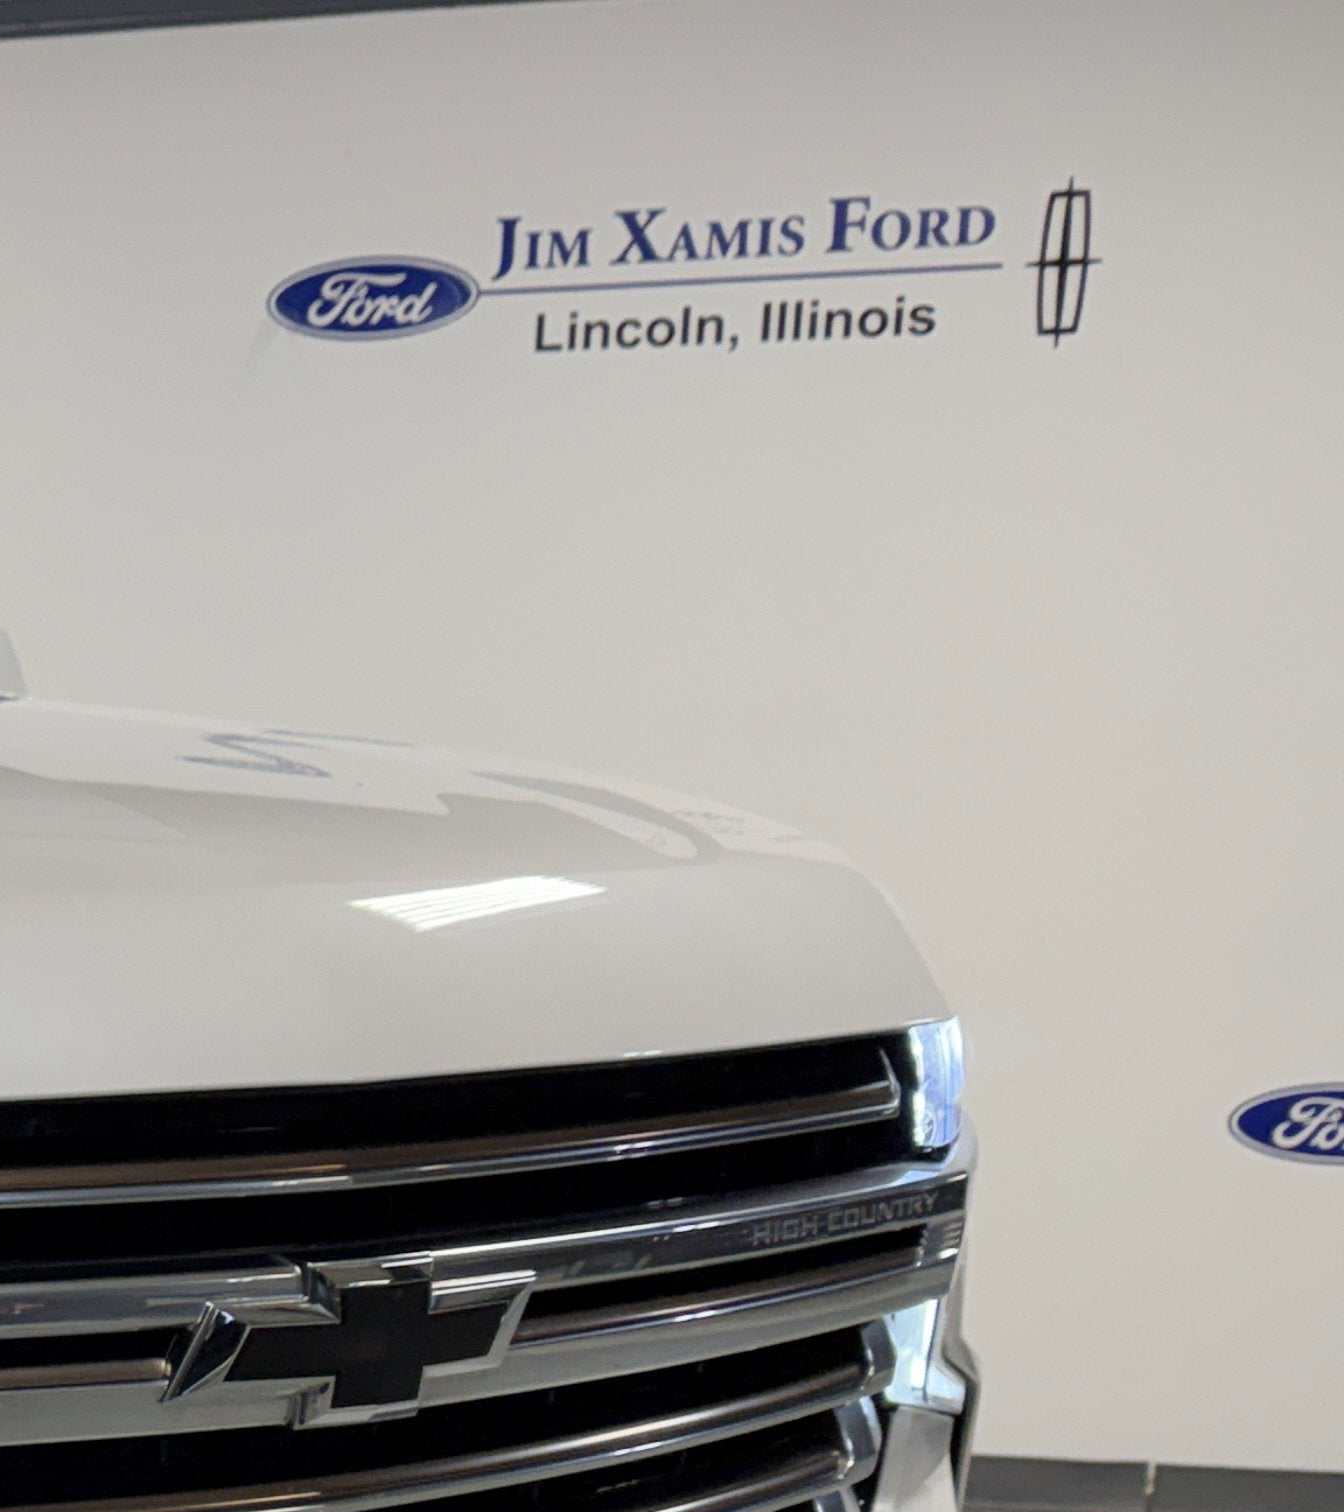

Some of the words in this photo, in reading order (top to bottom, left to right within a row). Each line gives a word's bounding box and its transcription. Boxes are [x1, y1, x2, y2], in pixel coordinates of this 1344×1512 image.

[490, 215, 593, 283] JIM
[608, 207, 807, 265] XAMIS
[825, 196, 997, 253] FORD
[306, 271, 439, 328] Ford
[534, 304, 740, 353] Lincoln,
[759, 295, 937, 343] Illinois
[1271, 1096, 1344, 1151] Fo
[751, 1216, 819, 1246] HIGH
[826, 1191, 941, 1232] COUNTRY
